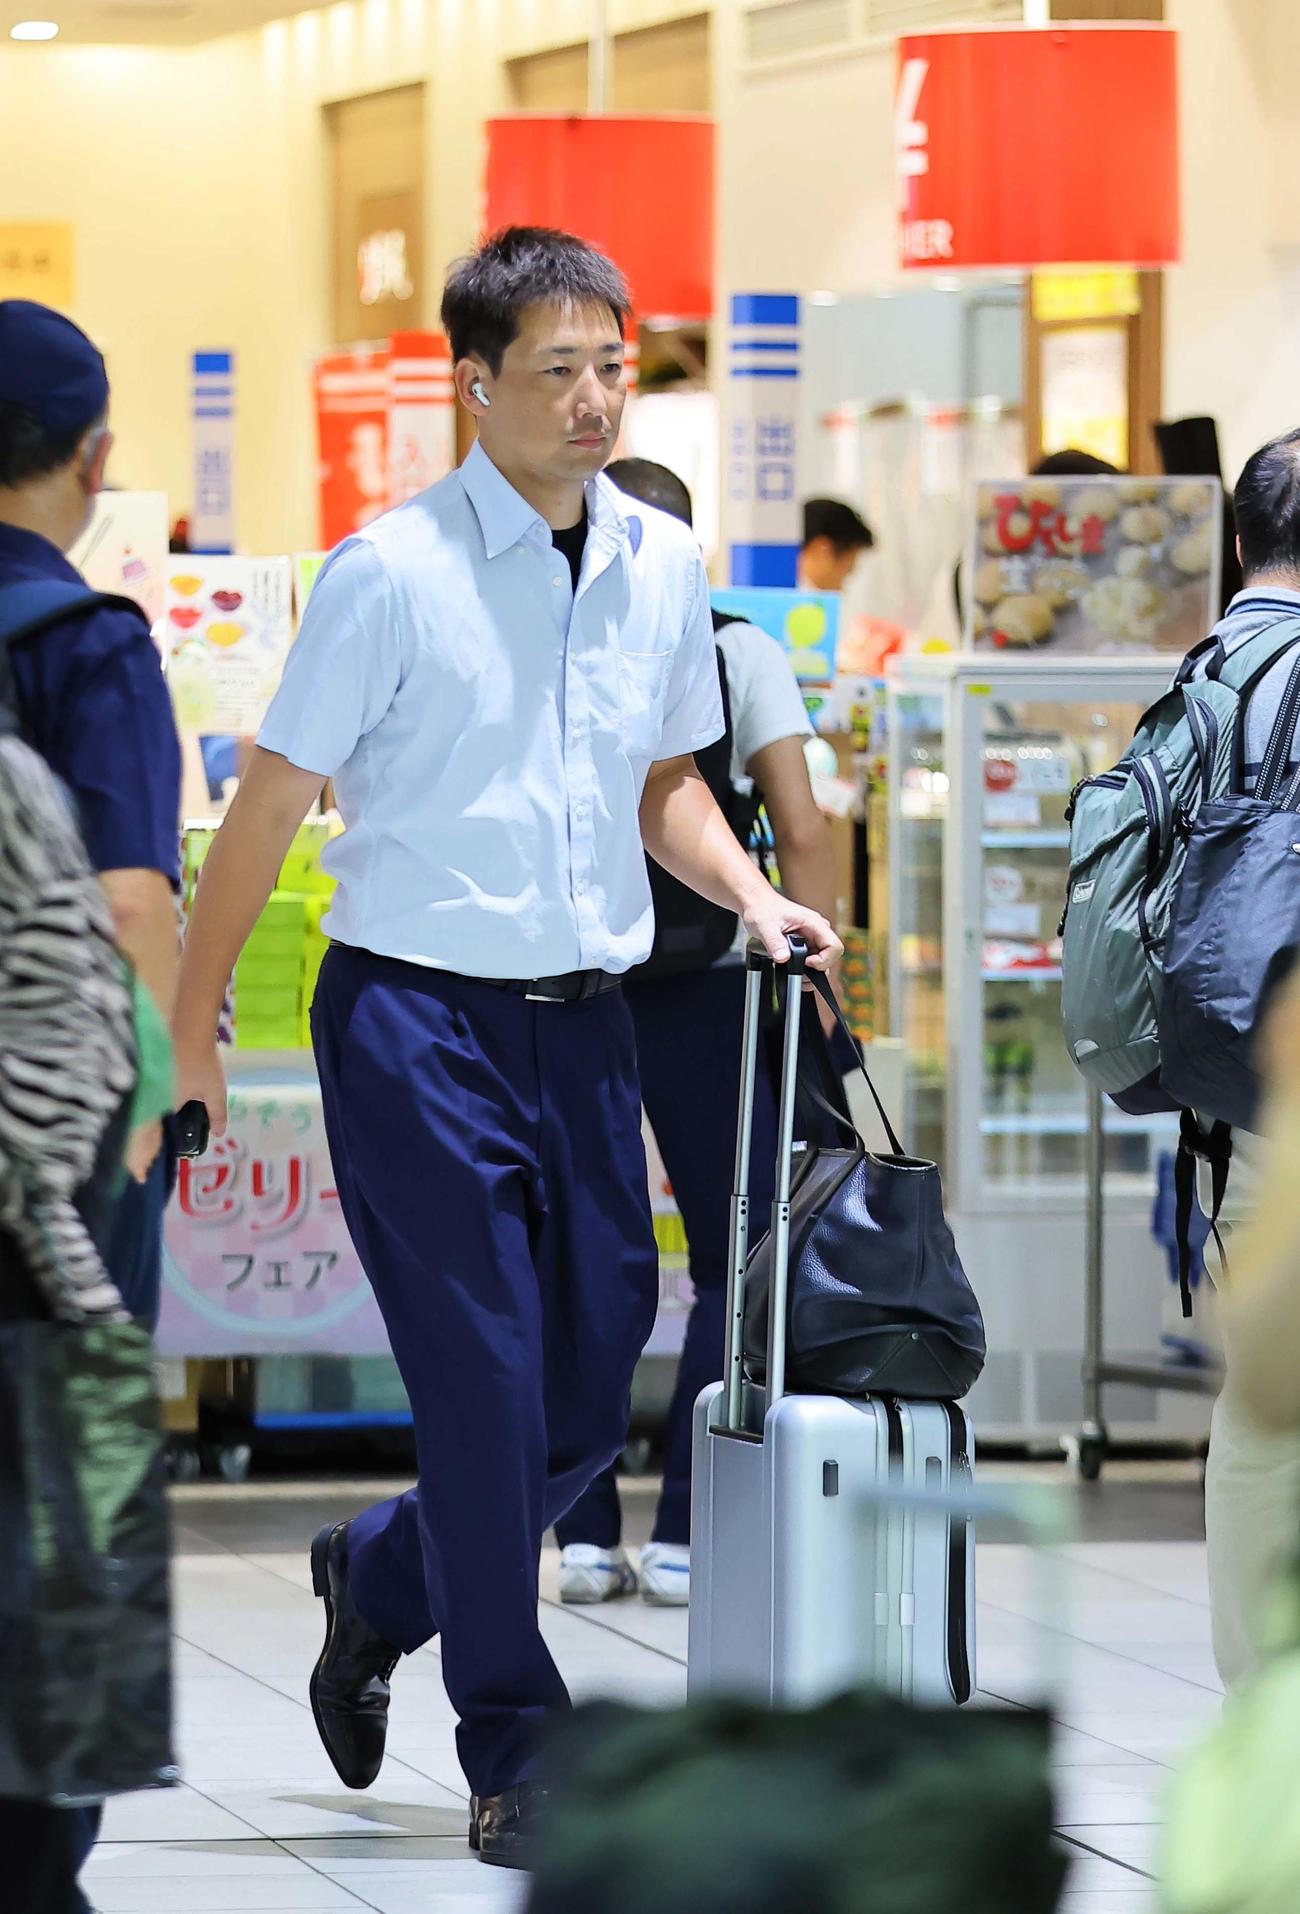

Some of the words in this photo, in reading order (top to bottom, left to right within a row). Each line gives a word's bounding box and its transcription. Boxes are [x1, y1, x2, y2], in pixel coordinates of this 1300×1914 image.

[756, 419, 795, 501] 出口
[221, 1251, 339, 1291] フェア
